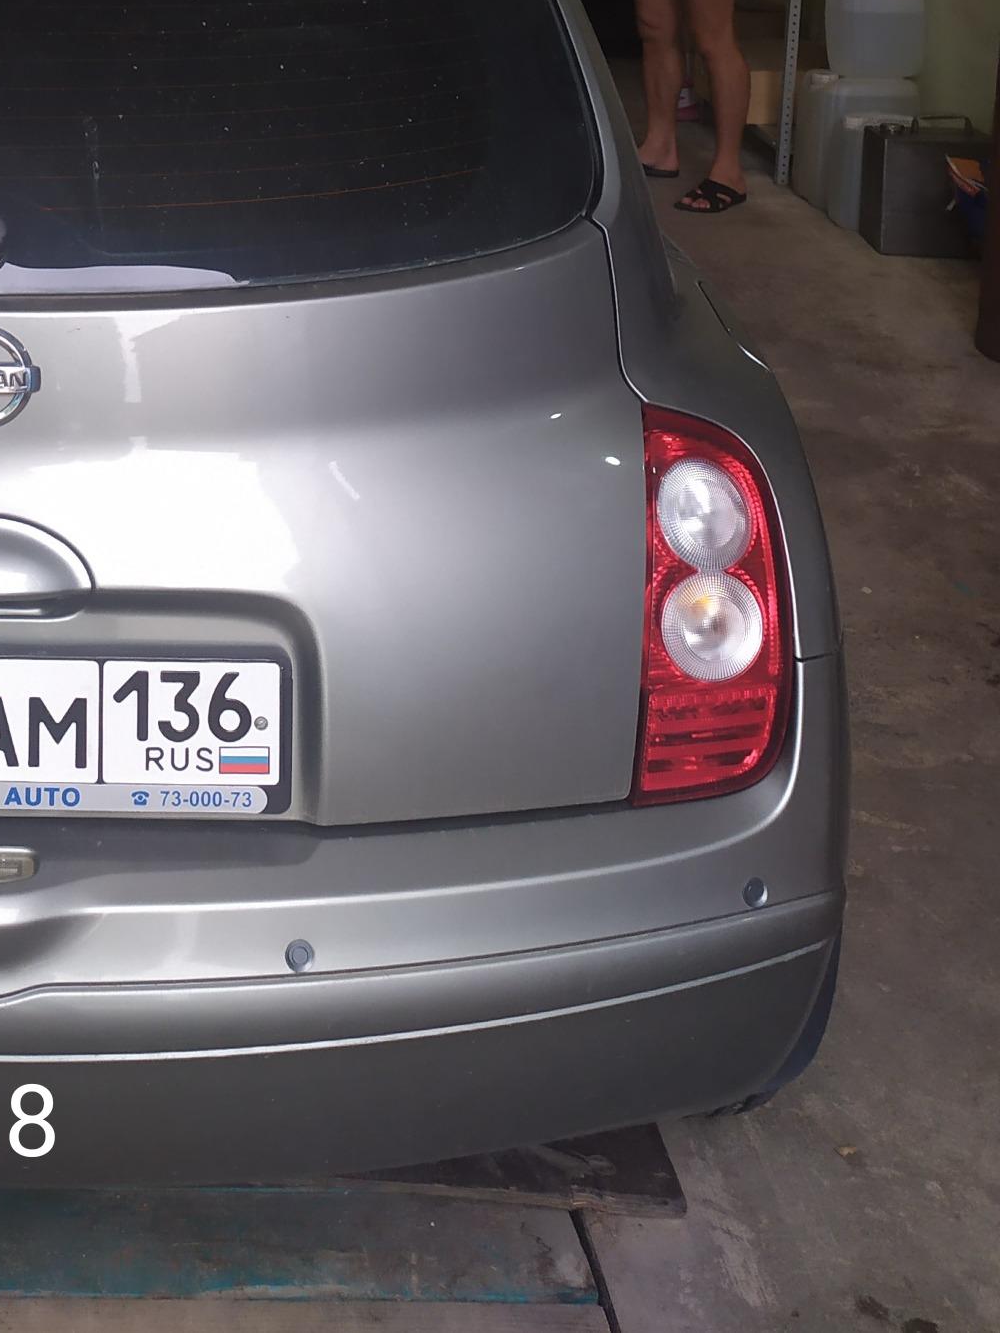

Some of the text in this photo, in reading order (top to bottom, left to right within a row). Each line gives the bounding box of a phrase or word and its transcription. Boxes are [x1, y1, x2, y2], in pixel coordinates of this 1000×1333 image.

[112, 670, 252, 743] 136
[145, 747, 214, 772] RUS
[4, 786, 81, 808] AUTO
[160, 791, 252, 808] 73-000-73
